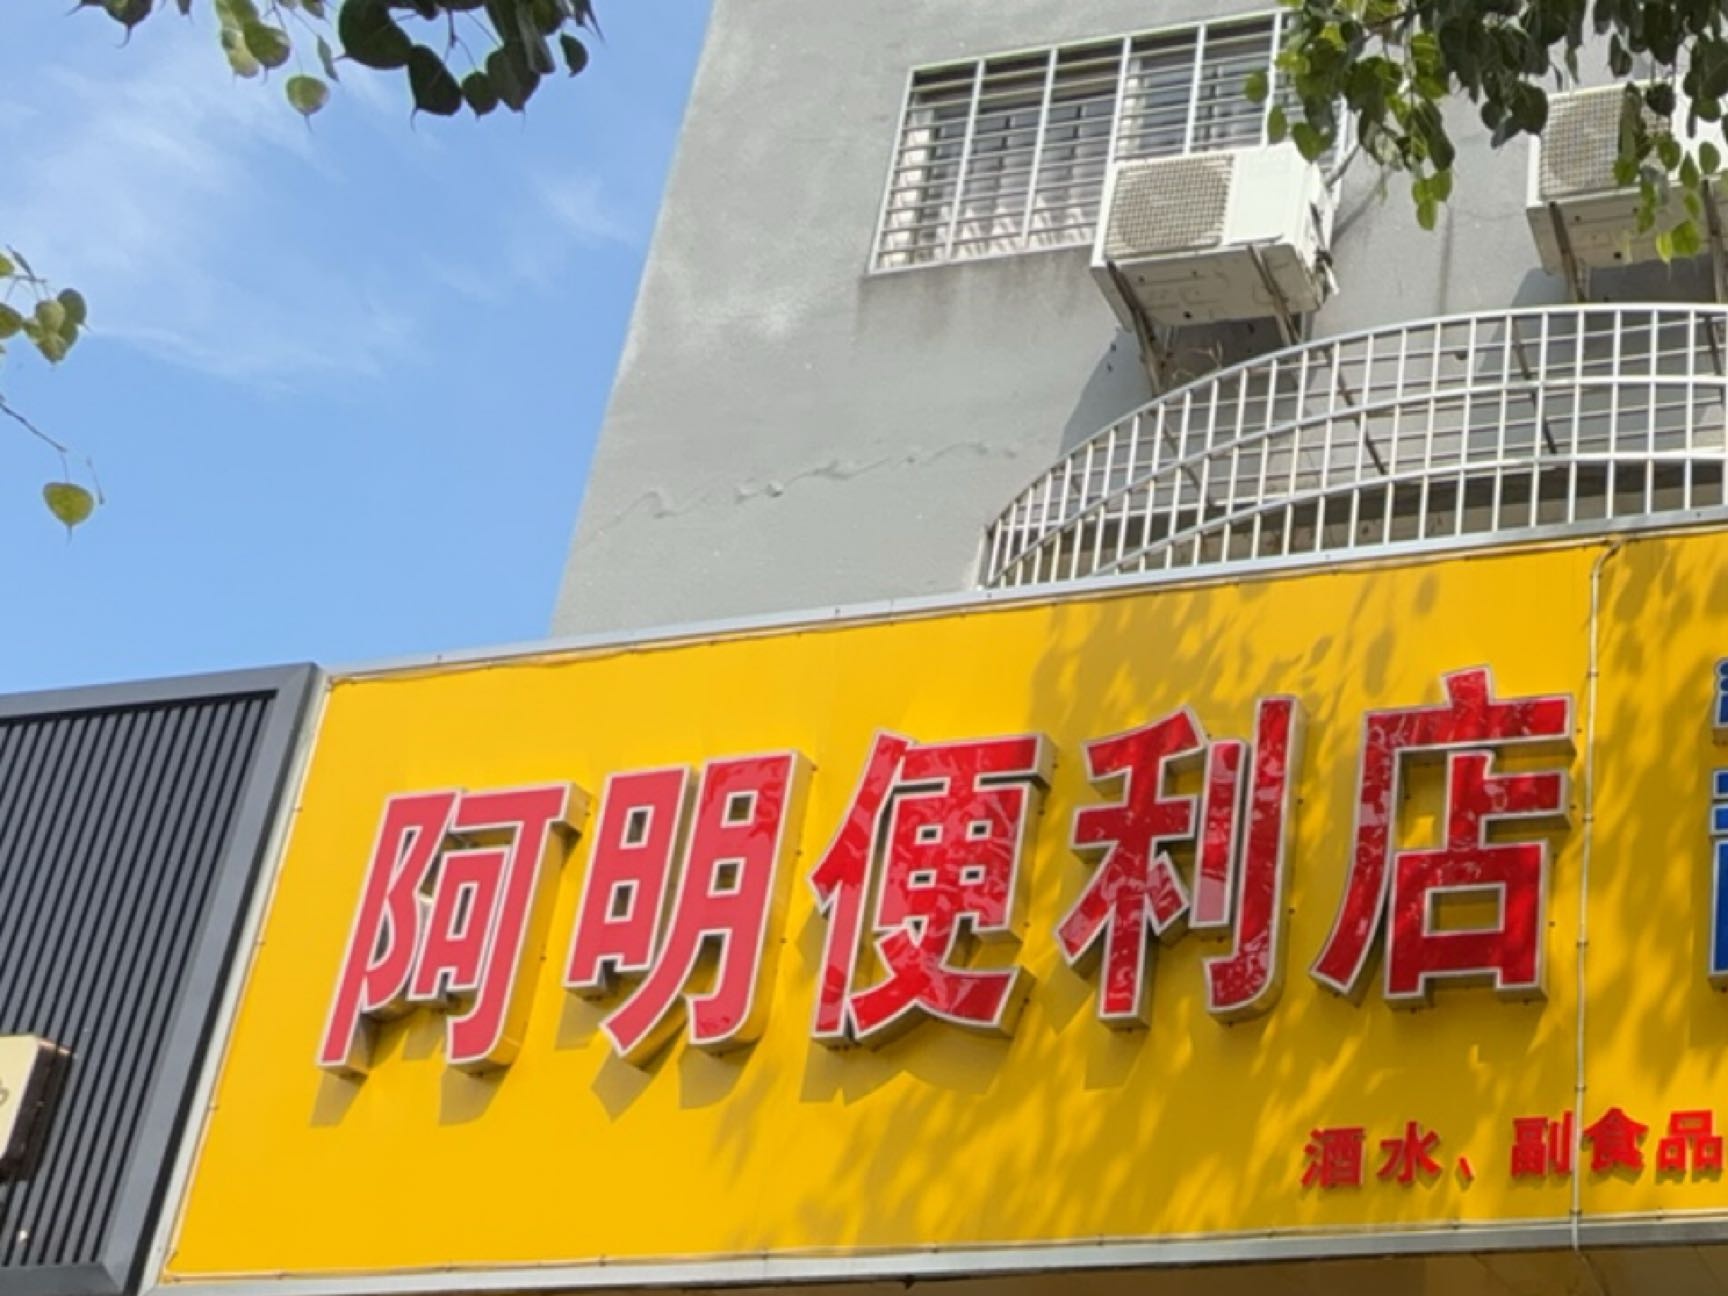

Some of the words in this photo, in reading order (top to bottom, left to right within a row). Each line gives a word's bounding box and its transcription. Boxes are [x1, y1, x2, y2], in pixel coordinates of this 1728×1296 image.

[318, 667, 1575, 1074] 阿明便利店
